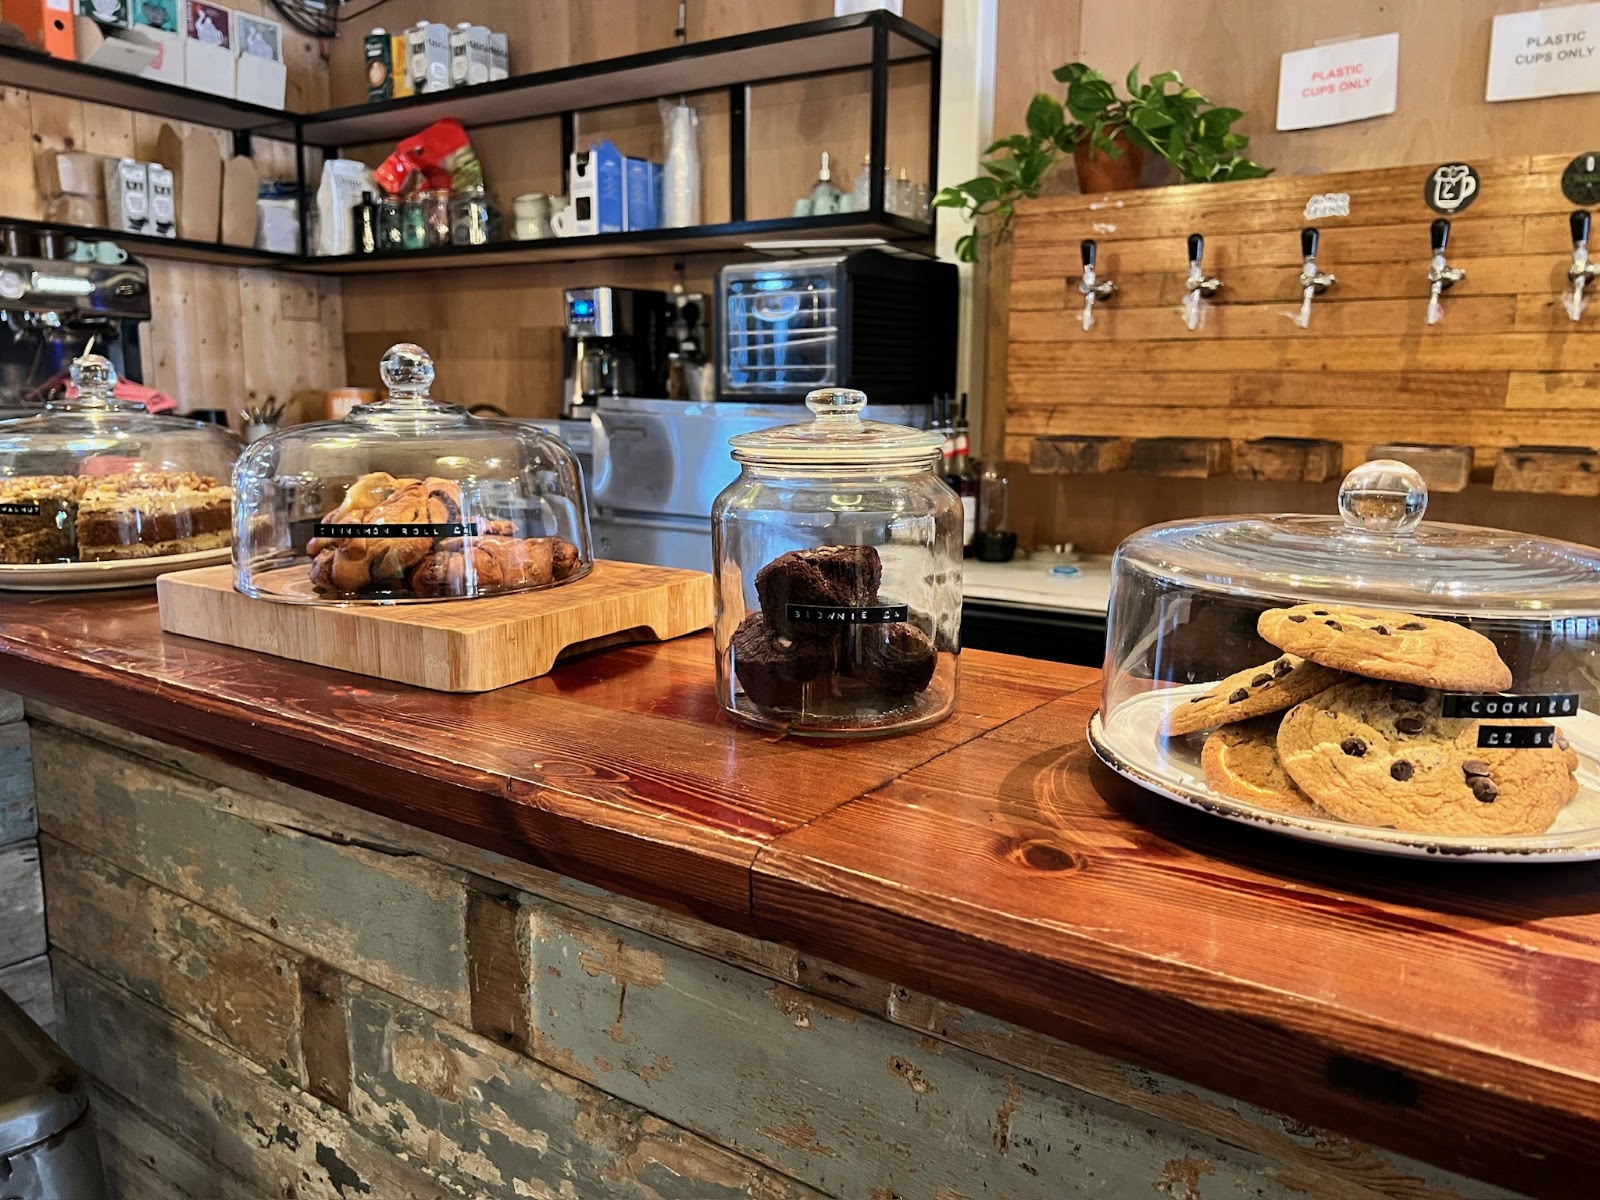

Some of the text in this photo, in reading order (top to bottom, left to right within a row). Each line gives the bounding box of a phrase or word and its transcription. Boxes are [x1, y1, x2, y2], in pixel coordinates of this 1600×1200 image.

[1526, 31, 1586, 49] PLASTIC
[1514, 46, 1595, 66] CUPS ONLY
[1311, 63, 1364, 81] PLASTIC
[1301, 76, 1372, 98] CUPS ONLY
[402, 527, 438, 535] ROLL
[1471, 699, 1571, 714] COOKIES
